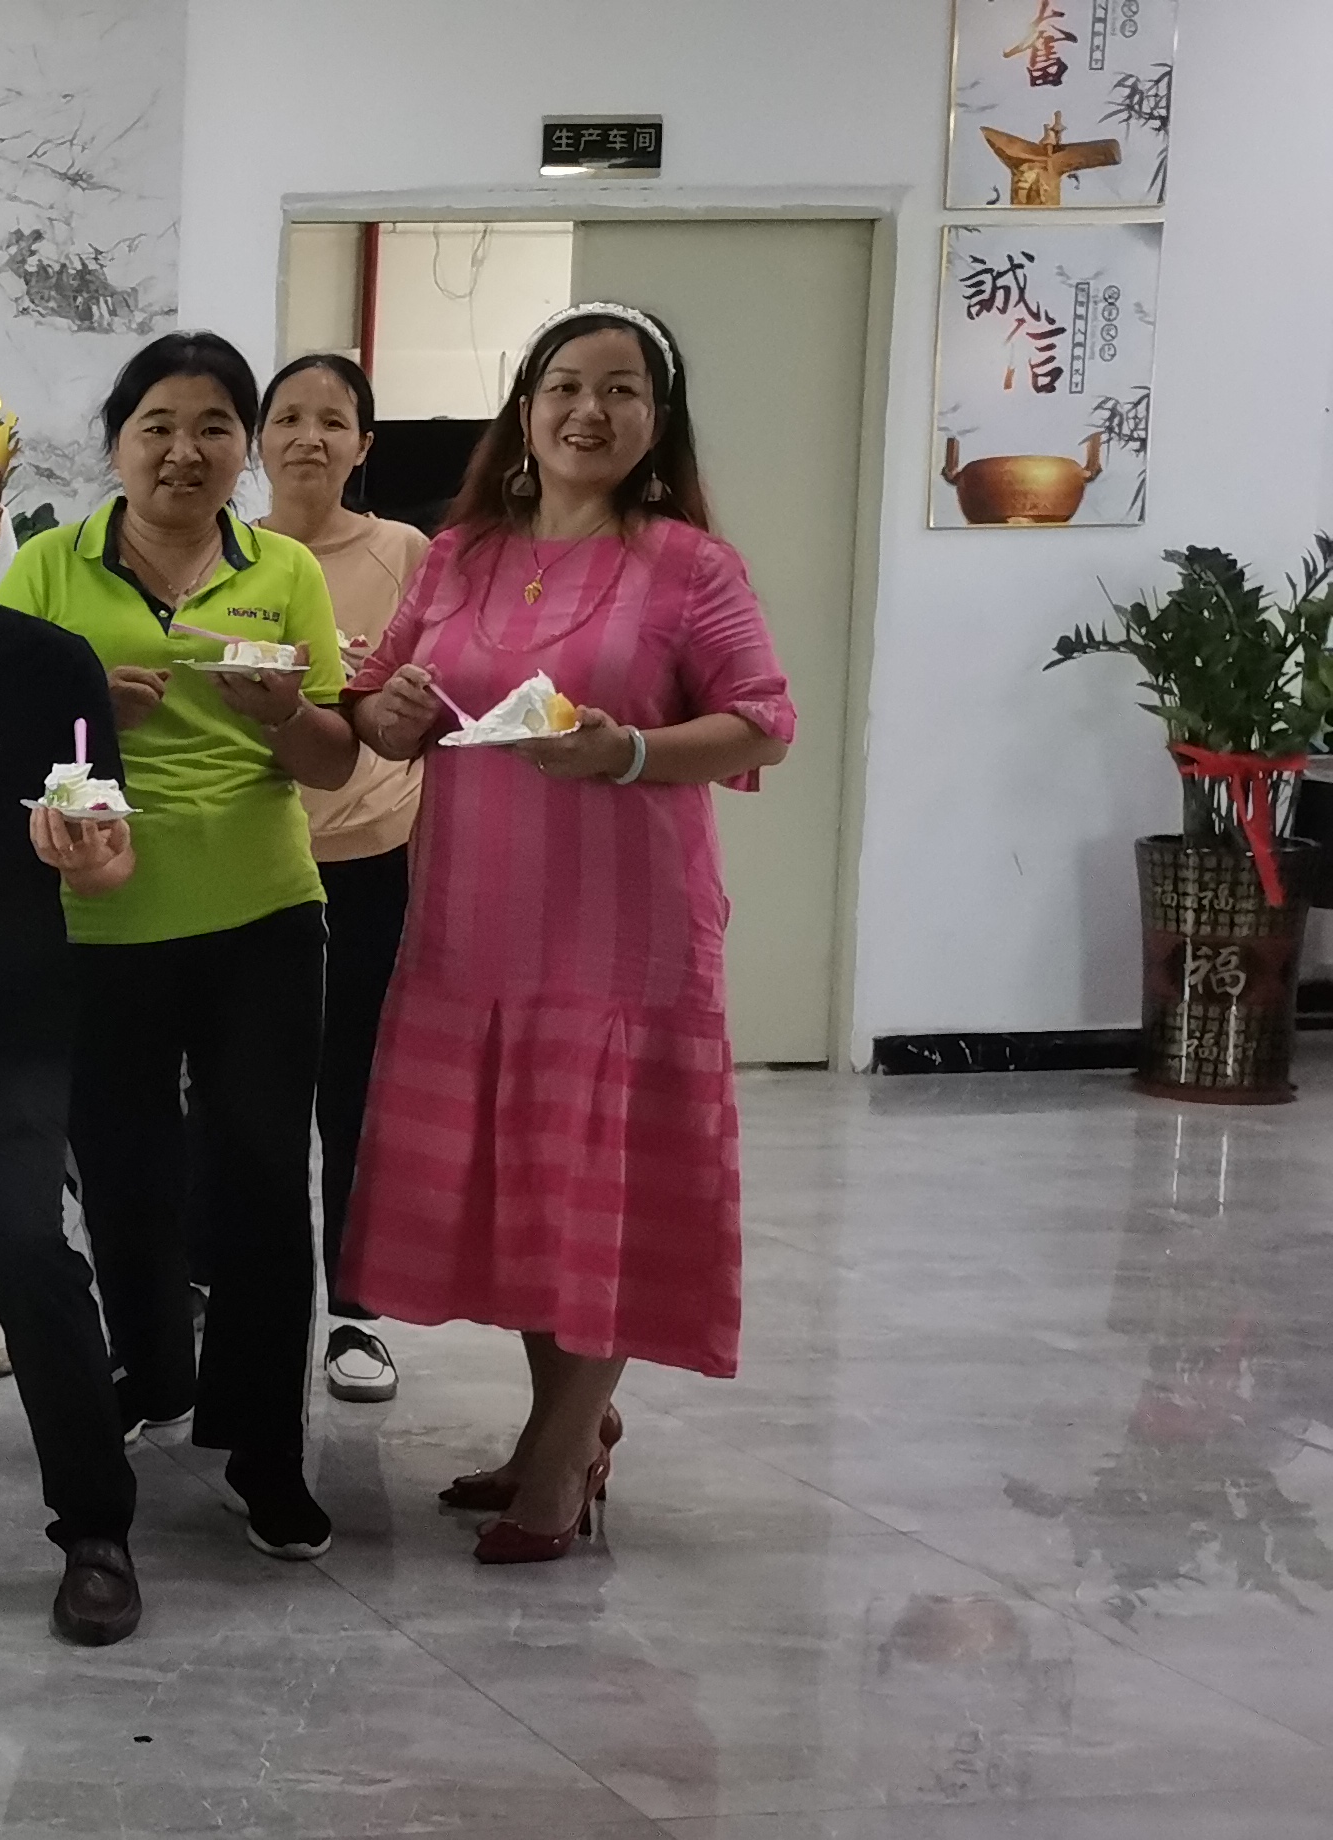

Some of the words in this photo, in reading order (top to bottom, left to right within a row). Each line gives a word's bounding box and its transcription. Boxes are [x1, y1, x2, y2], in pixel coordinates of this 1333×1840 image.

[551, 127, 657, 152] 生产车间
[959, 250, 1068, 394] 誠信
[1189, 945, 1247, 995] 福
